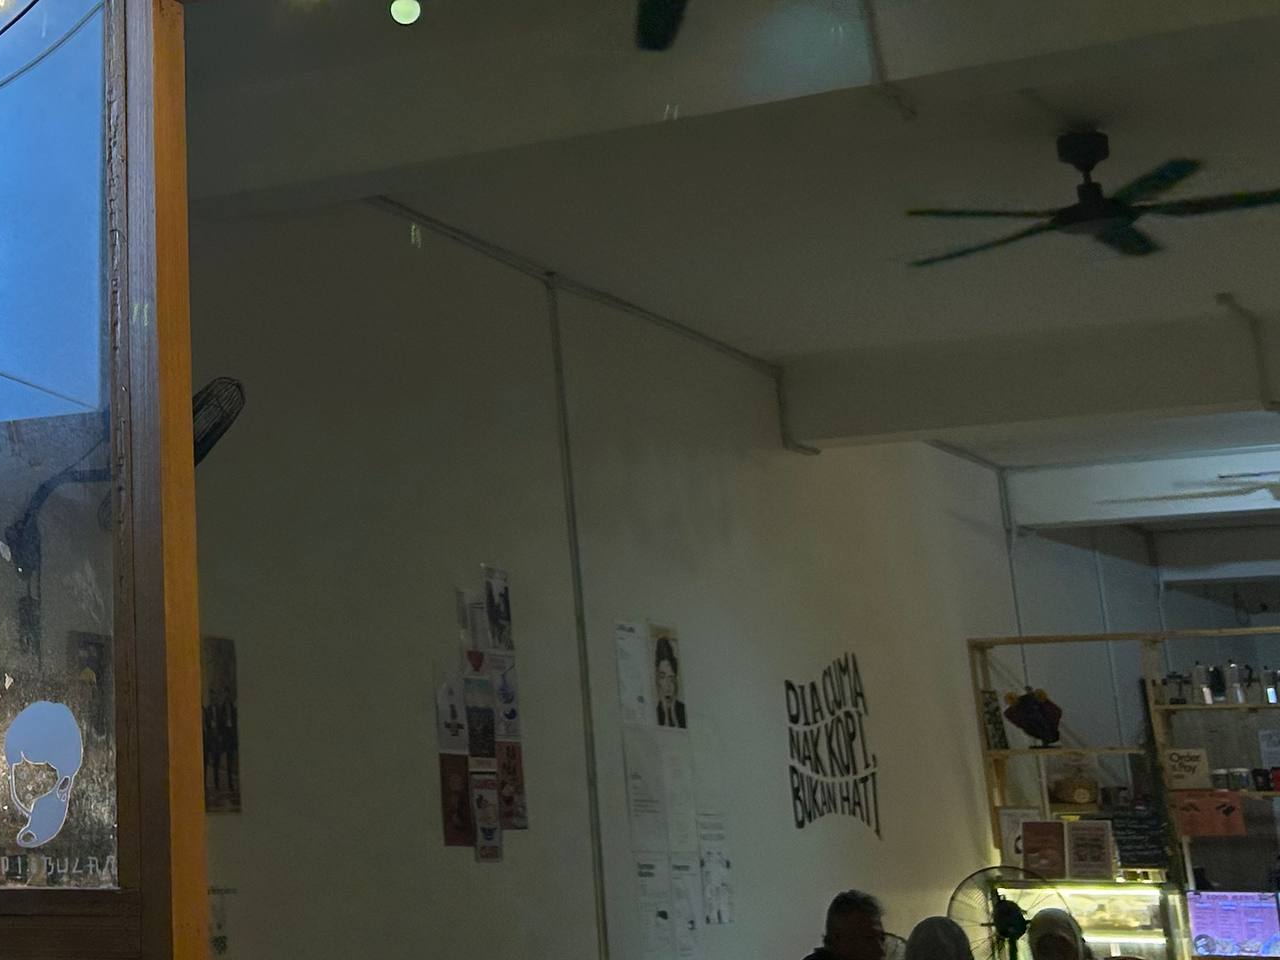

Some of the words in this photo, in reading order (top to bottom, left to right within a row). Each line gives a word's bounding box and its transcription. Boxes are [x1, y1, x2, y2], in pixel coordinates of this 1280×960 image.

[784, 678, 824, 726] DIA
[821, 652, 869, 717] CUMA
[788, 725, 827, 778] NAK
[788, 764, 838, 830] BUKAN
[838, 771, 883, 841] HATI
